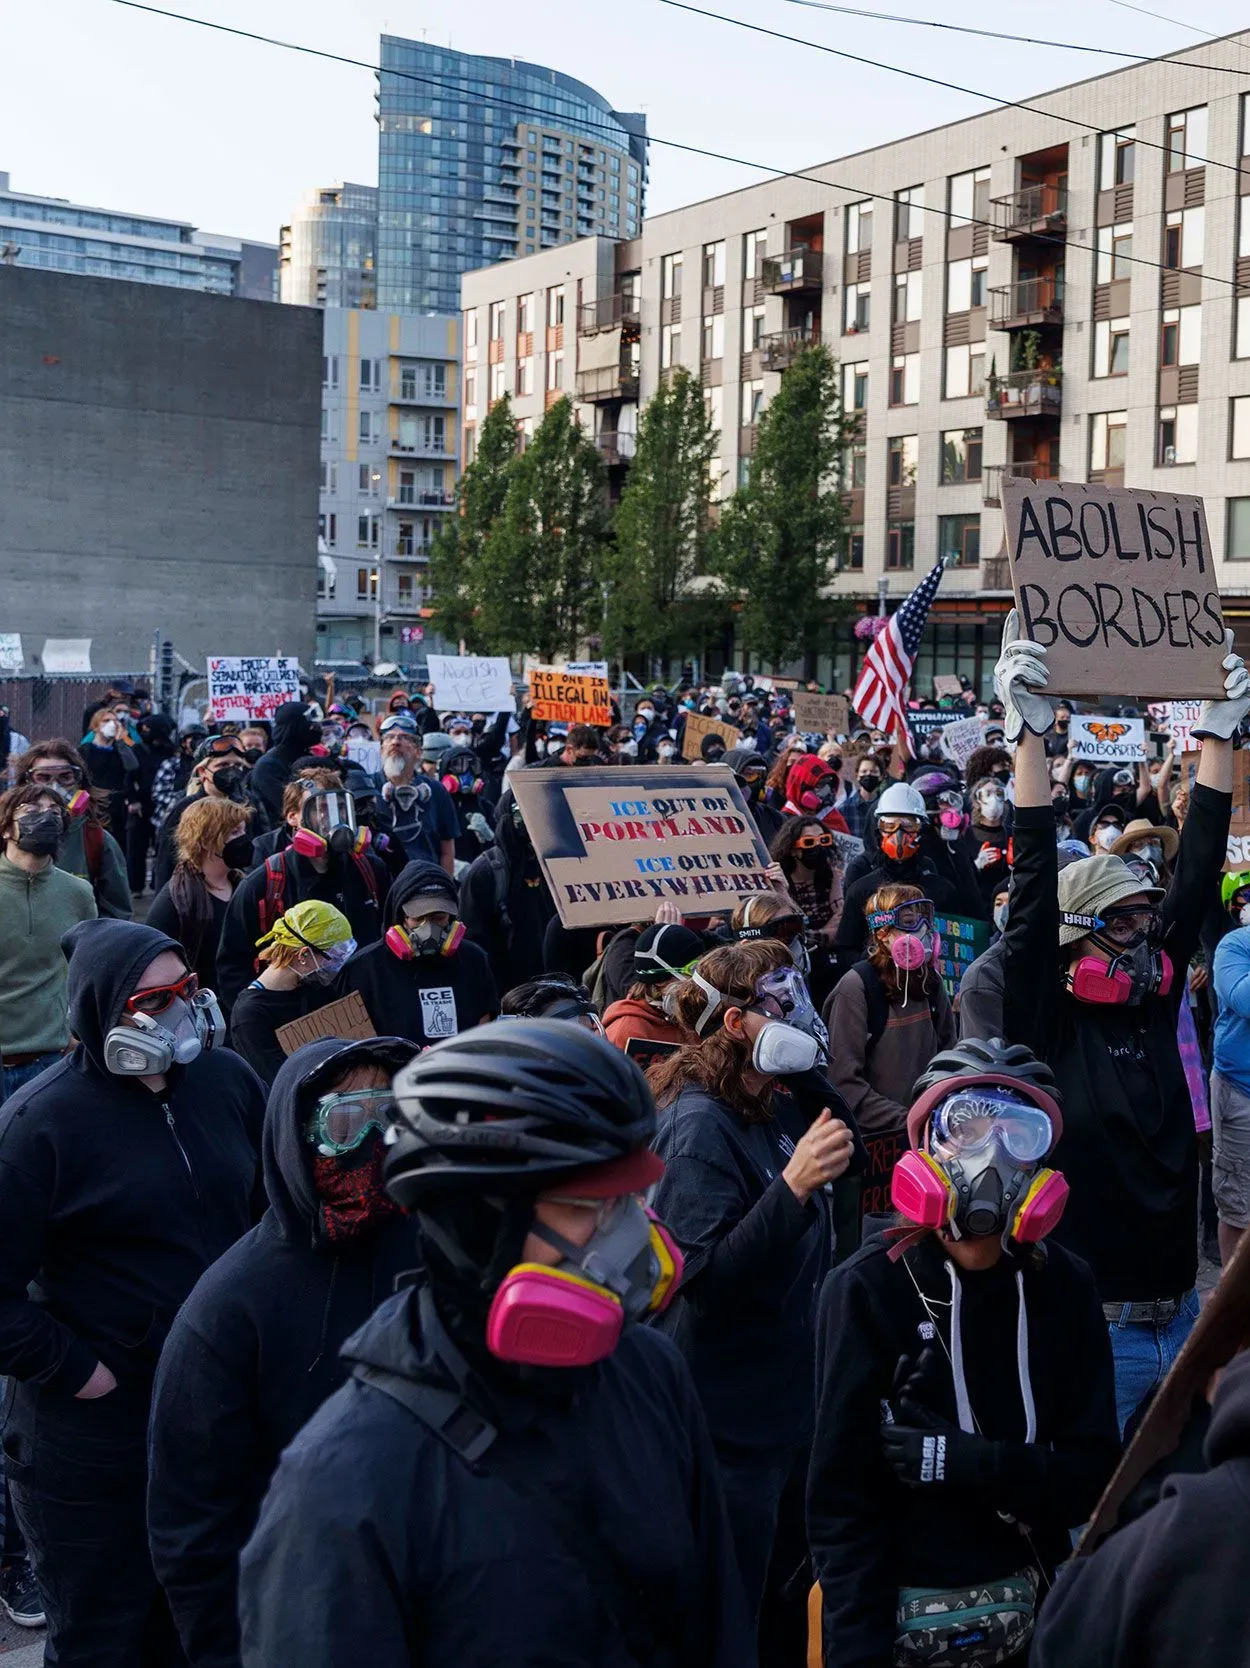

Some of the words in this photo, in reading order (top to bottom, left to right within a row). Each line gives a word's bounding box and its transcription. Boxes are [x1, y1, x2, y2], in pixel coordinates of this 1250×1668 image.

[1015, 497, 1205, 573] ABOLISH
[1019, 583, 1226, 649] BORDERS
[212, 684, 237, 695] FROM
[244, 682, 281, 694] PARENTS
[285, 682, 297, 693] IS
[534, 672, 553, 682] NO
[562, 675, 584, 685] ONE
[590, 677, 605, 687] IS
[451, 683, 497, 702] ICE
[532, 683, 589, 705] ILLEGAL
[593, 692, 608, 707] ON
[1076, 741, 1094, 753] NO
[1096, 743, 1146, 757] BORDERS
[610, 801, 650, 817] ICE
[652, 798, 697, 819] OUT
[702, 797, 728, 812] OF
[579, 816, 746, 842] PORTLAND
[635, 856, 676, 873] ICE
[678, 853, 722, 872] OUT
[728, 853, 756, 869] OF
[564, 873, 771, 904] EVERYWHERE
[739, 929, 761, 938] SMITH
[922, 1330, 934, 1340] ICE
[935, 1435, 946, 1481] KOBALT
